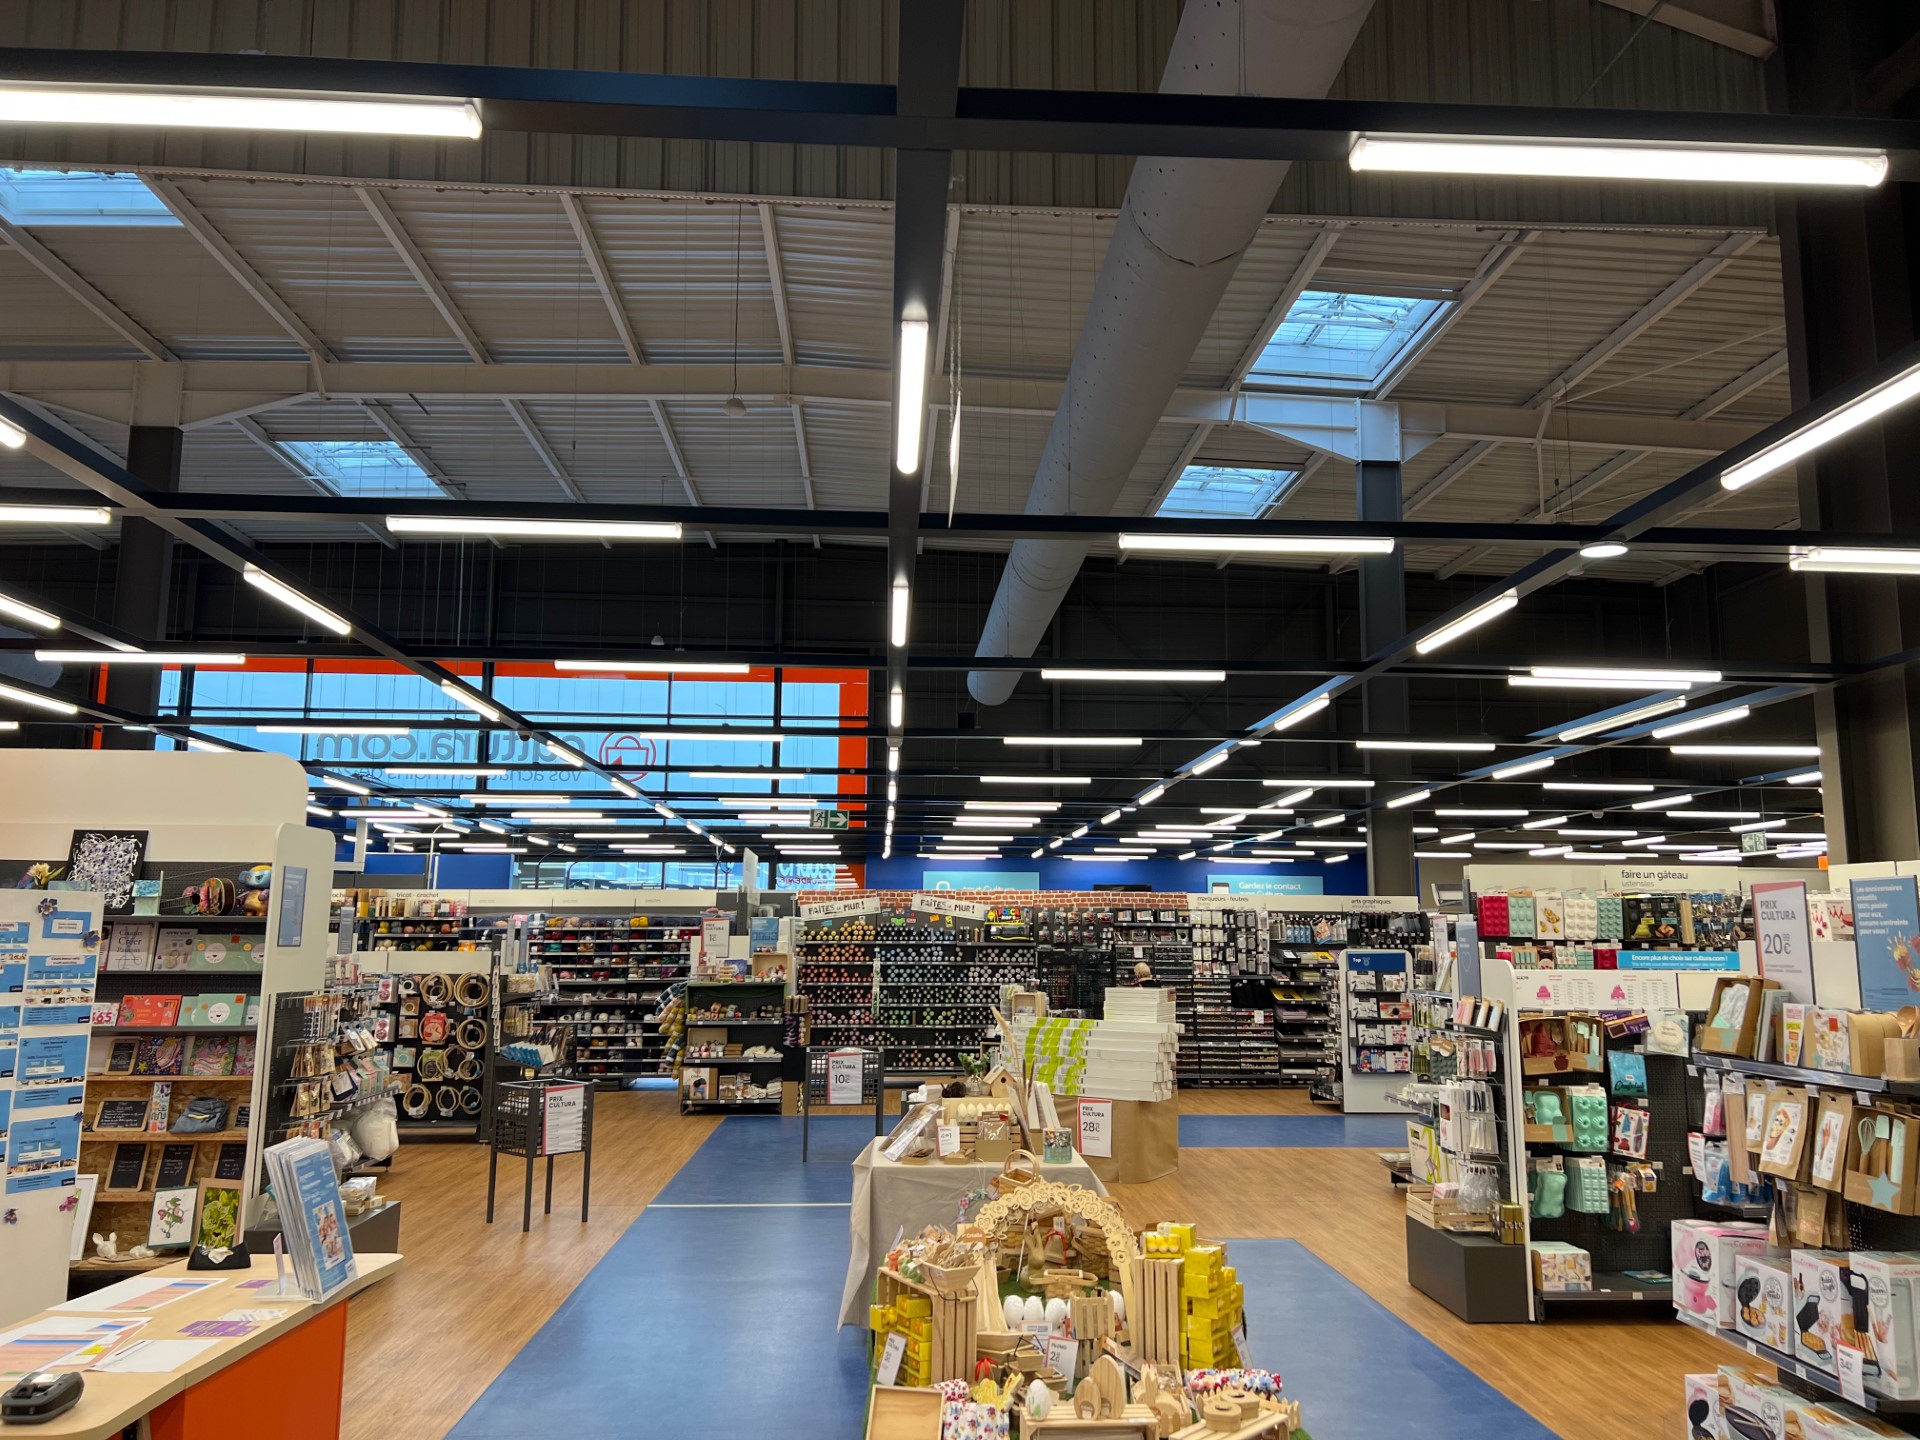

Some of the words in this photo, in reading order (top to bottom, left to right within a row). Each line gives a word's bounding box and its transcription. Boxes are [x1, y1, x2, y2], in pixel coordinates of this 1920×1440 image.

[1621, 870, 1642, 879] faire
[1657, 871, 1688, 881] gâteau
[1238, 882, 1263, 890] Gardez
[1265, 882, 1272, 890] le
[1273, 882, 1302, 890] contact
[1760, 900, 1778, 910] PRIX
[1761, 910, 1796, 921] CULTURA
[1764, 934, 1783, 954] 20
[834, 1074, 844, 1084] 10
[1082, 1122, 1095, 1132] 28
